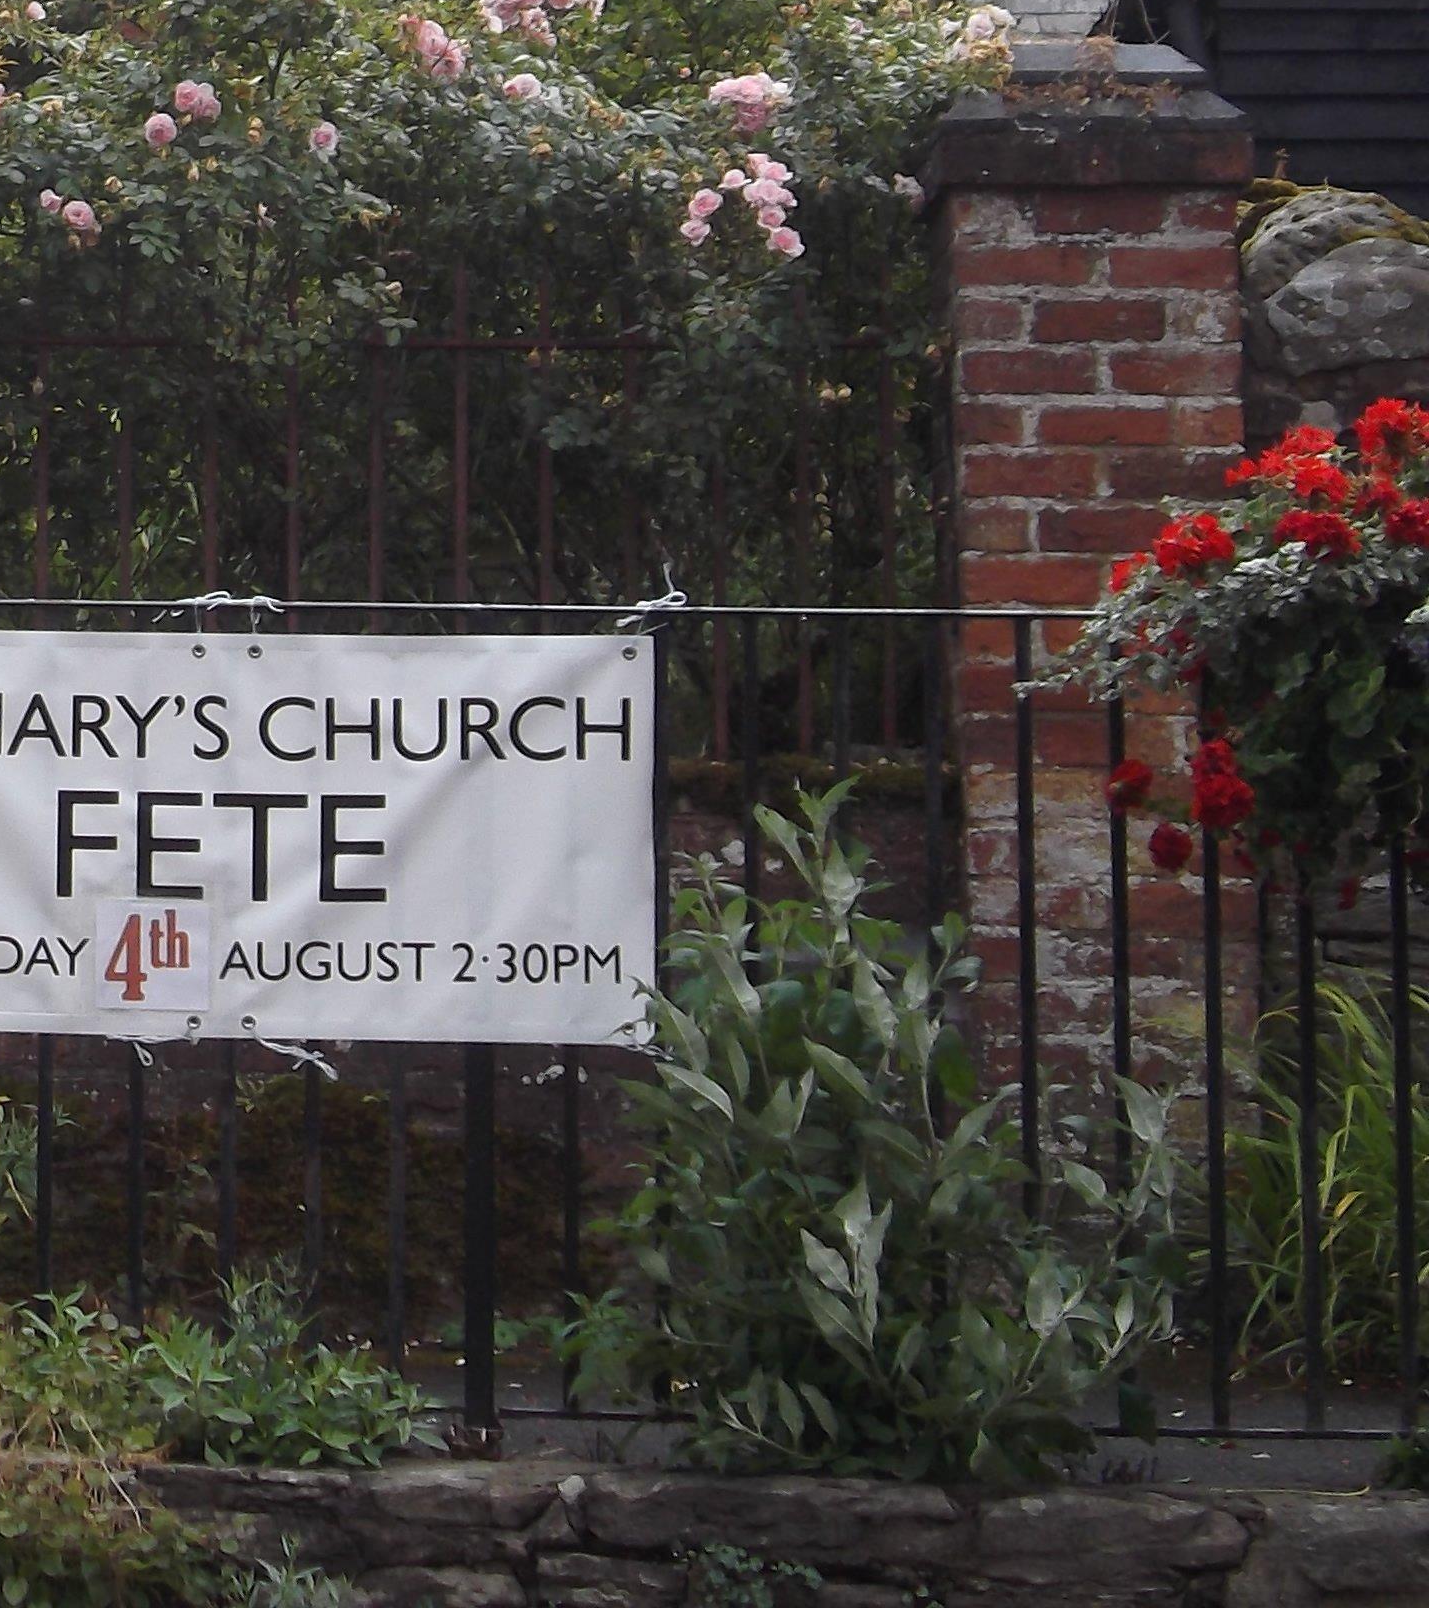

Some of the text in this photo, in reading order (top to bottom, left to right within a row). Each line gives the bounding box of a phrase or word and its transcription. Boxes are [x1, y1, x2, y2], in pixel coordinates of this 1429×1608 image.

[258, 696, 631, 762] CHURCH
[56, 789, 387, 903] FETE
[104, 909, 190, 1002] 4th
[219, 941, 435, 983] AUGUST
